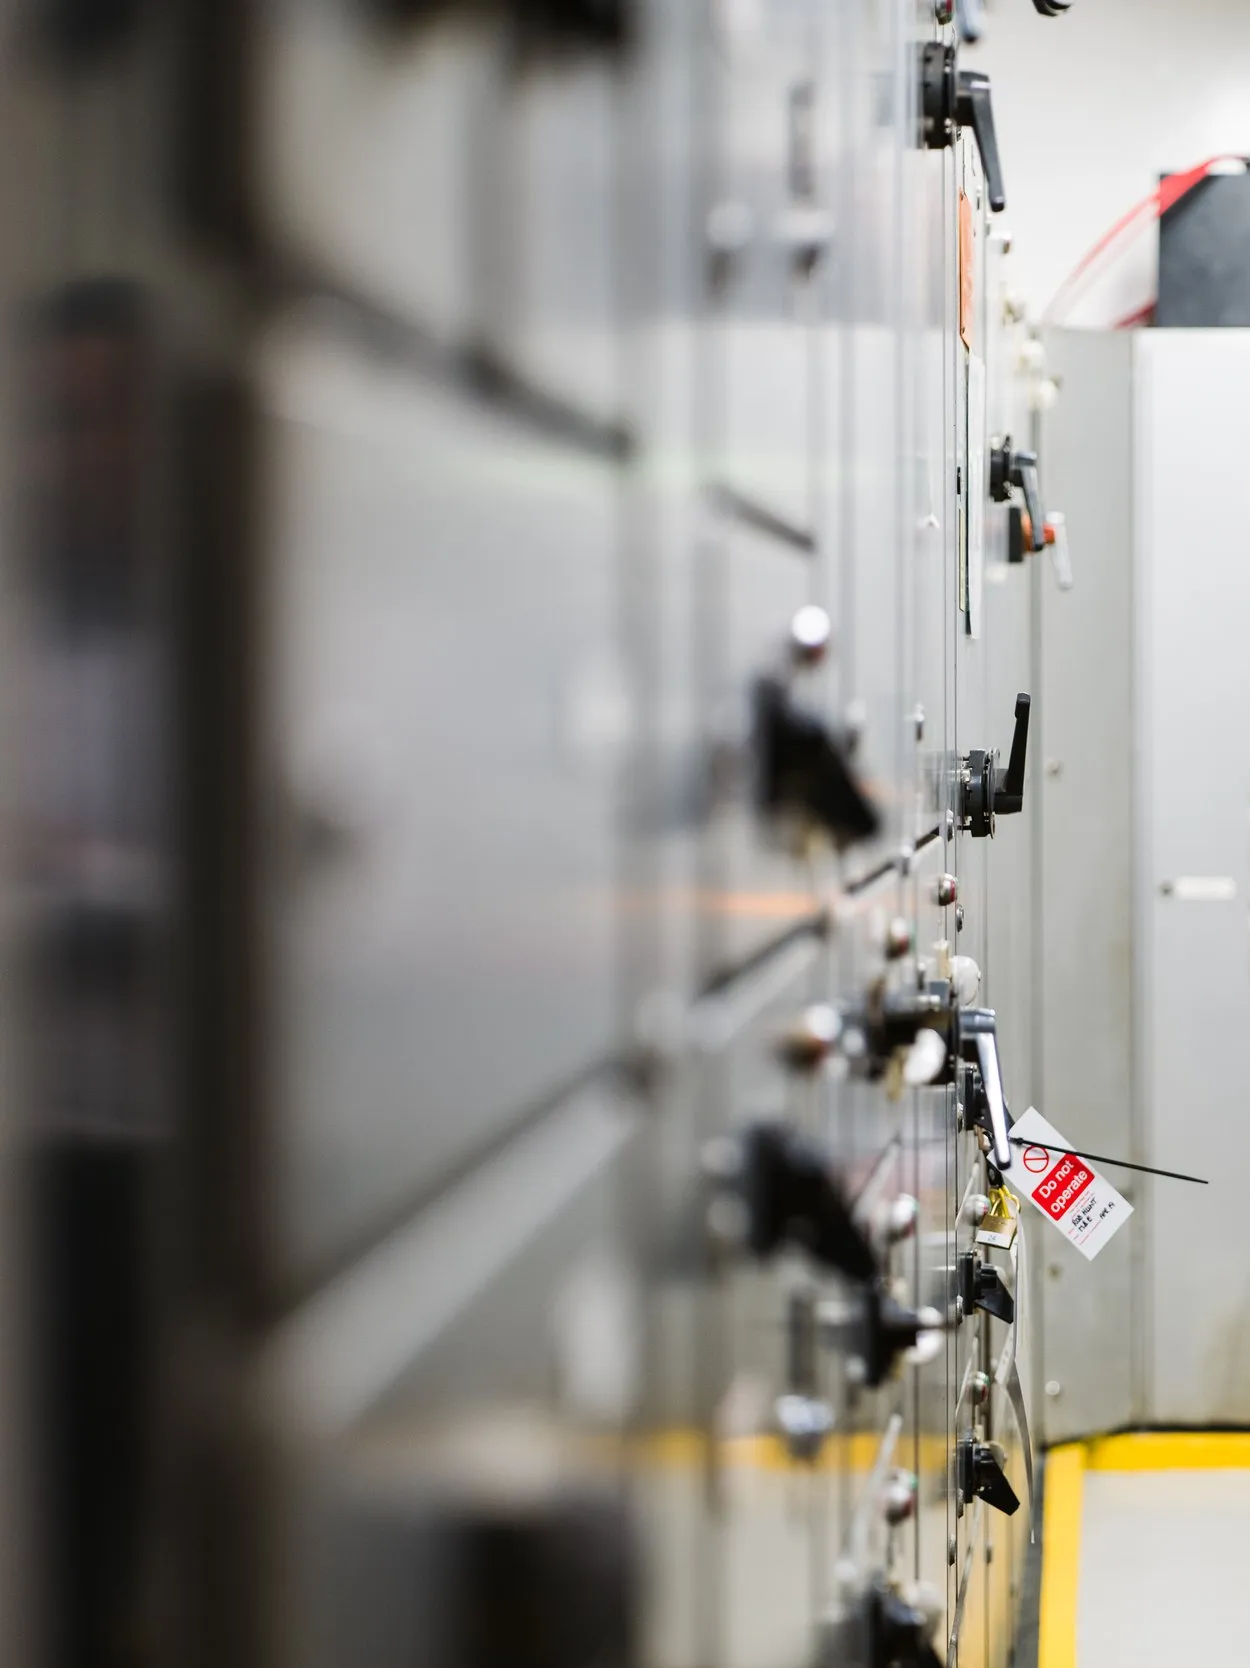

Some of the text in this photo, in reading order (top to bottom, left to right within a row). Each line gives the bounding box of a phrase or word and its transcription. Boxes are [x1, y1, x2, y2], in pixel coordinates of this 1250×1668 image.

[1039, 1161, 1073, 1198] Do not
[1051, 1171, 1087, 1212] operate
